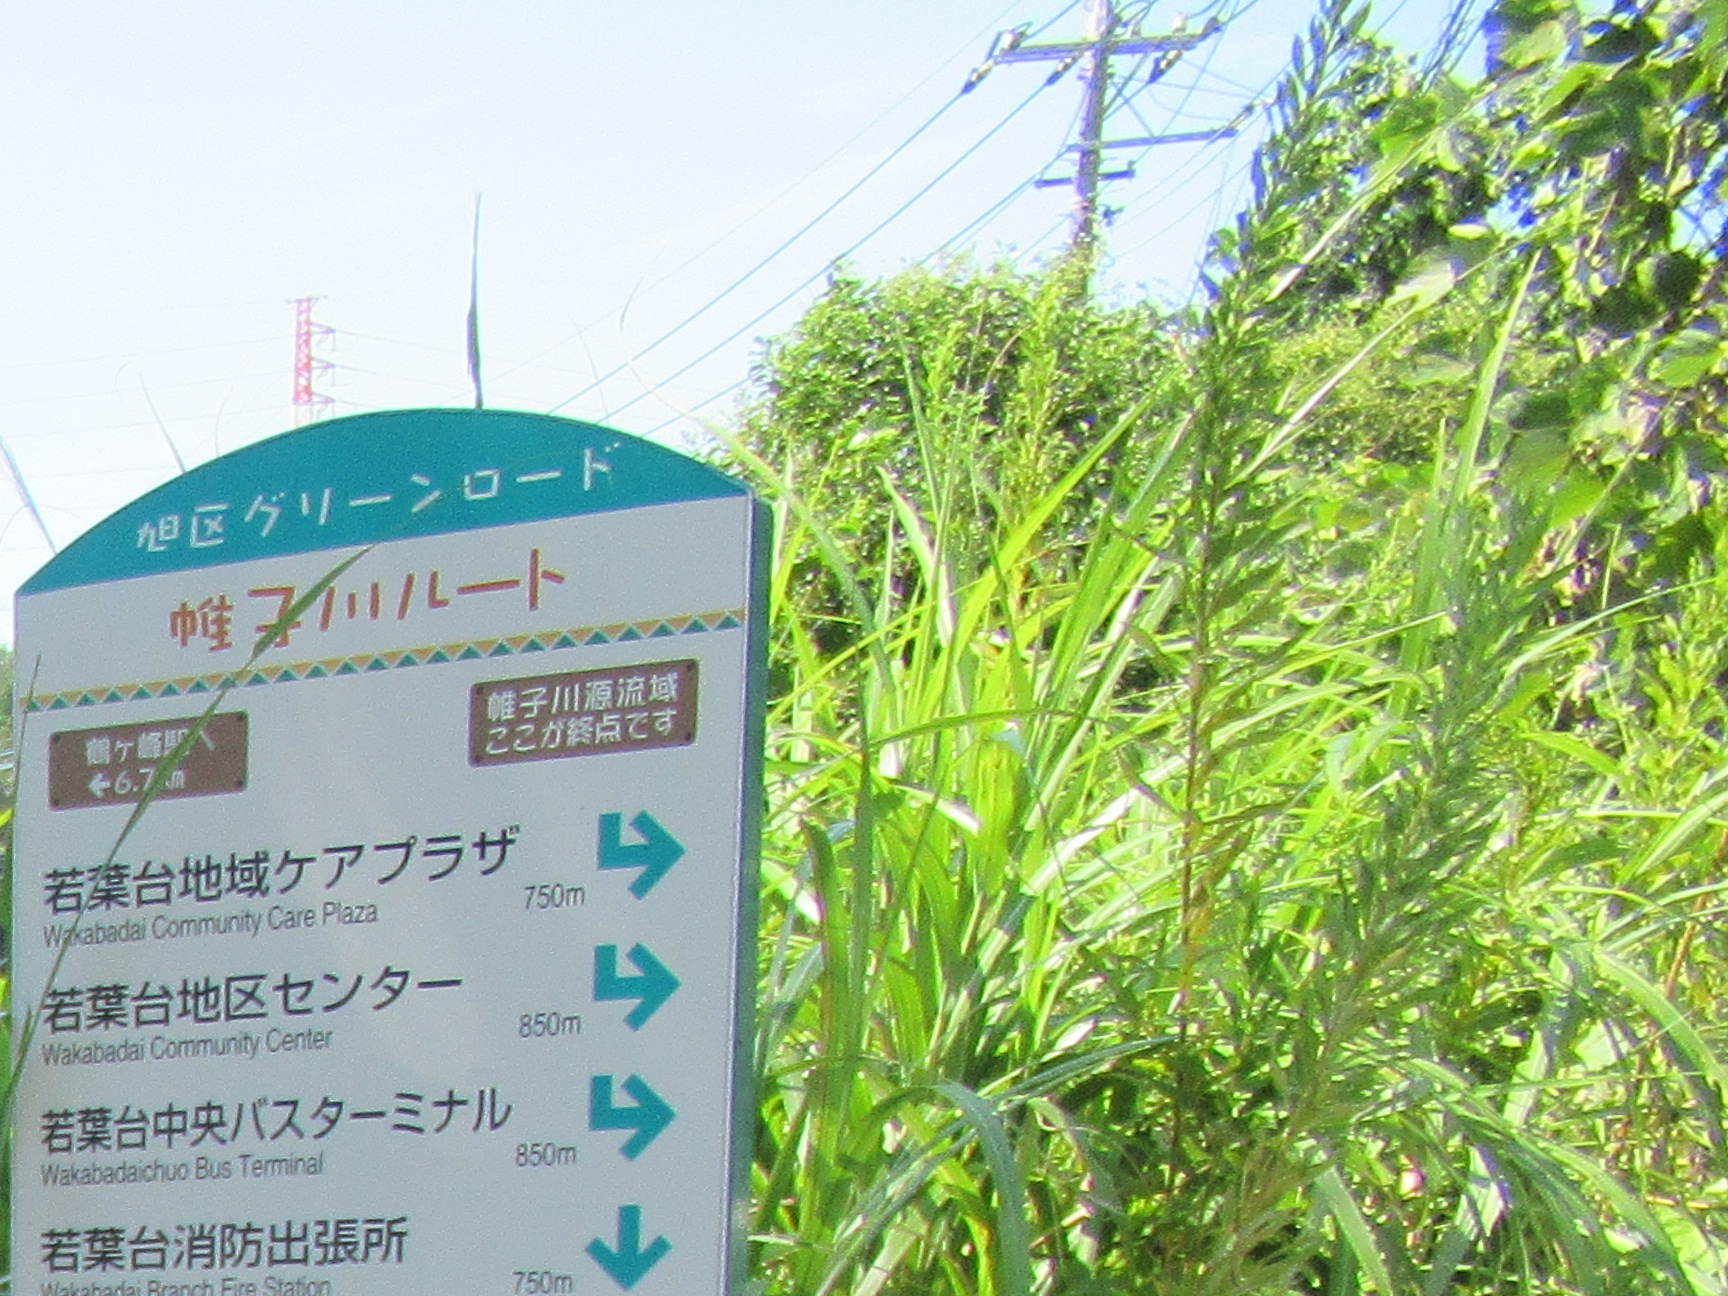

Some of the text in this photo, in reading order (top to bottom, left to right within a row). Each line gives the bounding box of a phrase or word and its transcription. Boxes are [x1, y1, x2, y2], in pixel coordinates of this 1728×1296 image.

[136, 440, 622, 553] 旭区グリーンロード
[169, 547, 566, 652] 帷子川ルート
[487, 672, 678, 721] 帷子川源流域
[485, 708, 677, 755] ここが終点です
[114, 768, 185, 795] 6.7m
[43, 825, 521, 915] 若葉台地域ケアプラザ
[524, 882, 585, 911] 750m
[43, 899, 378, 948] Wakabadai Community Care Plaza
[41, 965, 463, 1035] 若葉台地区センター
[41, 1027, 332, 1067] Wakabadai Community Center
[519, 1011, 581, 1038] 850m
[40, 1086, 512, 1157] 若葉台中央バスターミナル
[40, 1153, 324, 1188] Wakabadaichuo Bus Terminal
[515, 1141, 577, 1168] 850m
[40, 1216, 409, 1276] 若葉台消防出張所
[513, 1269, 573, 1296] 750m
